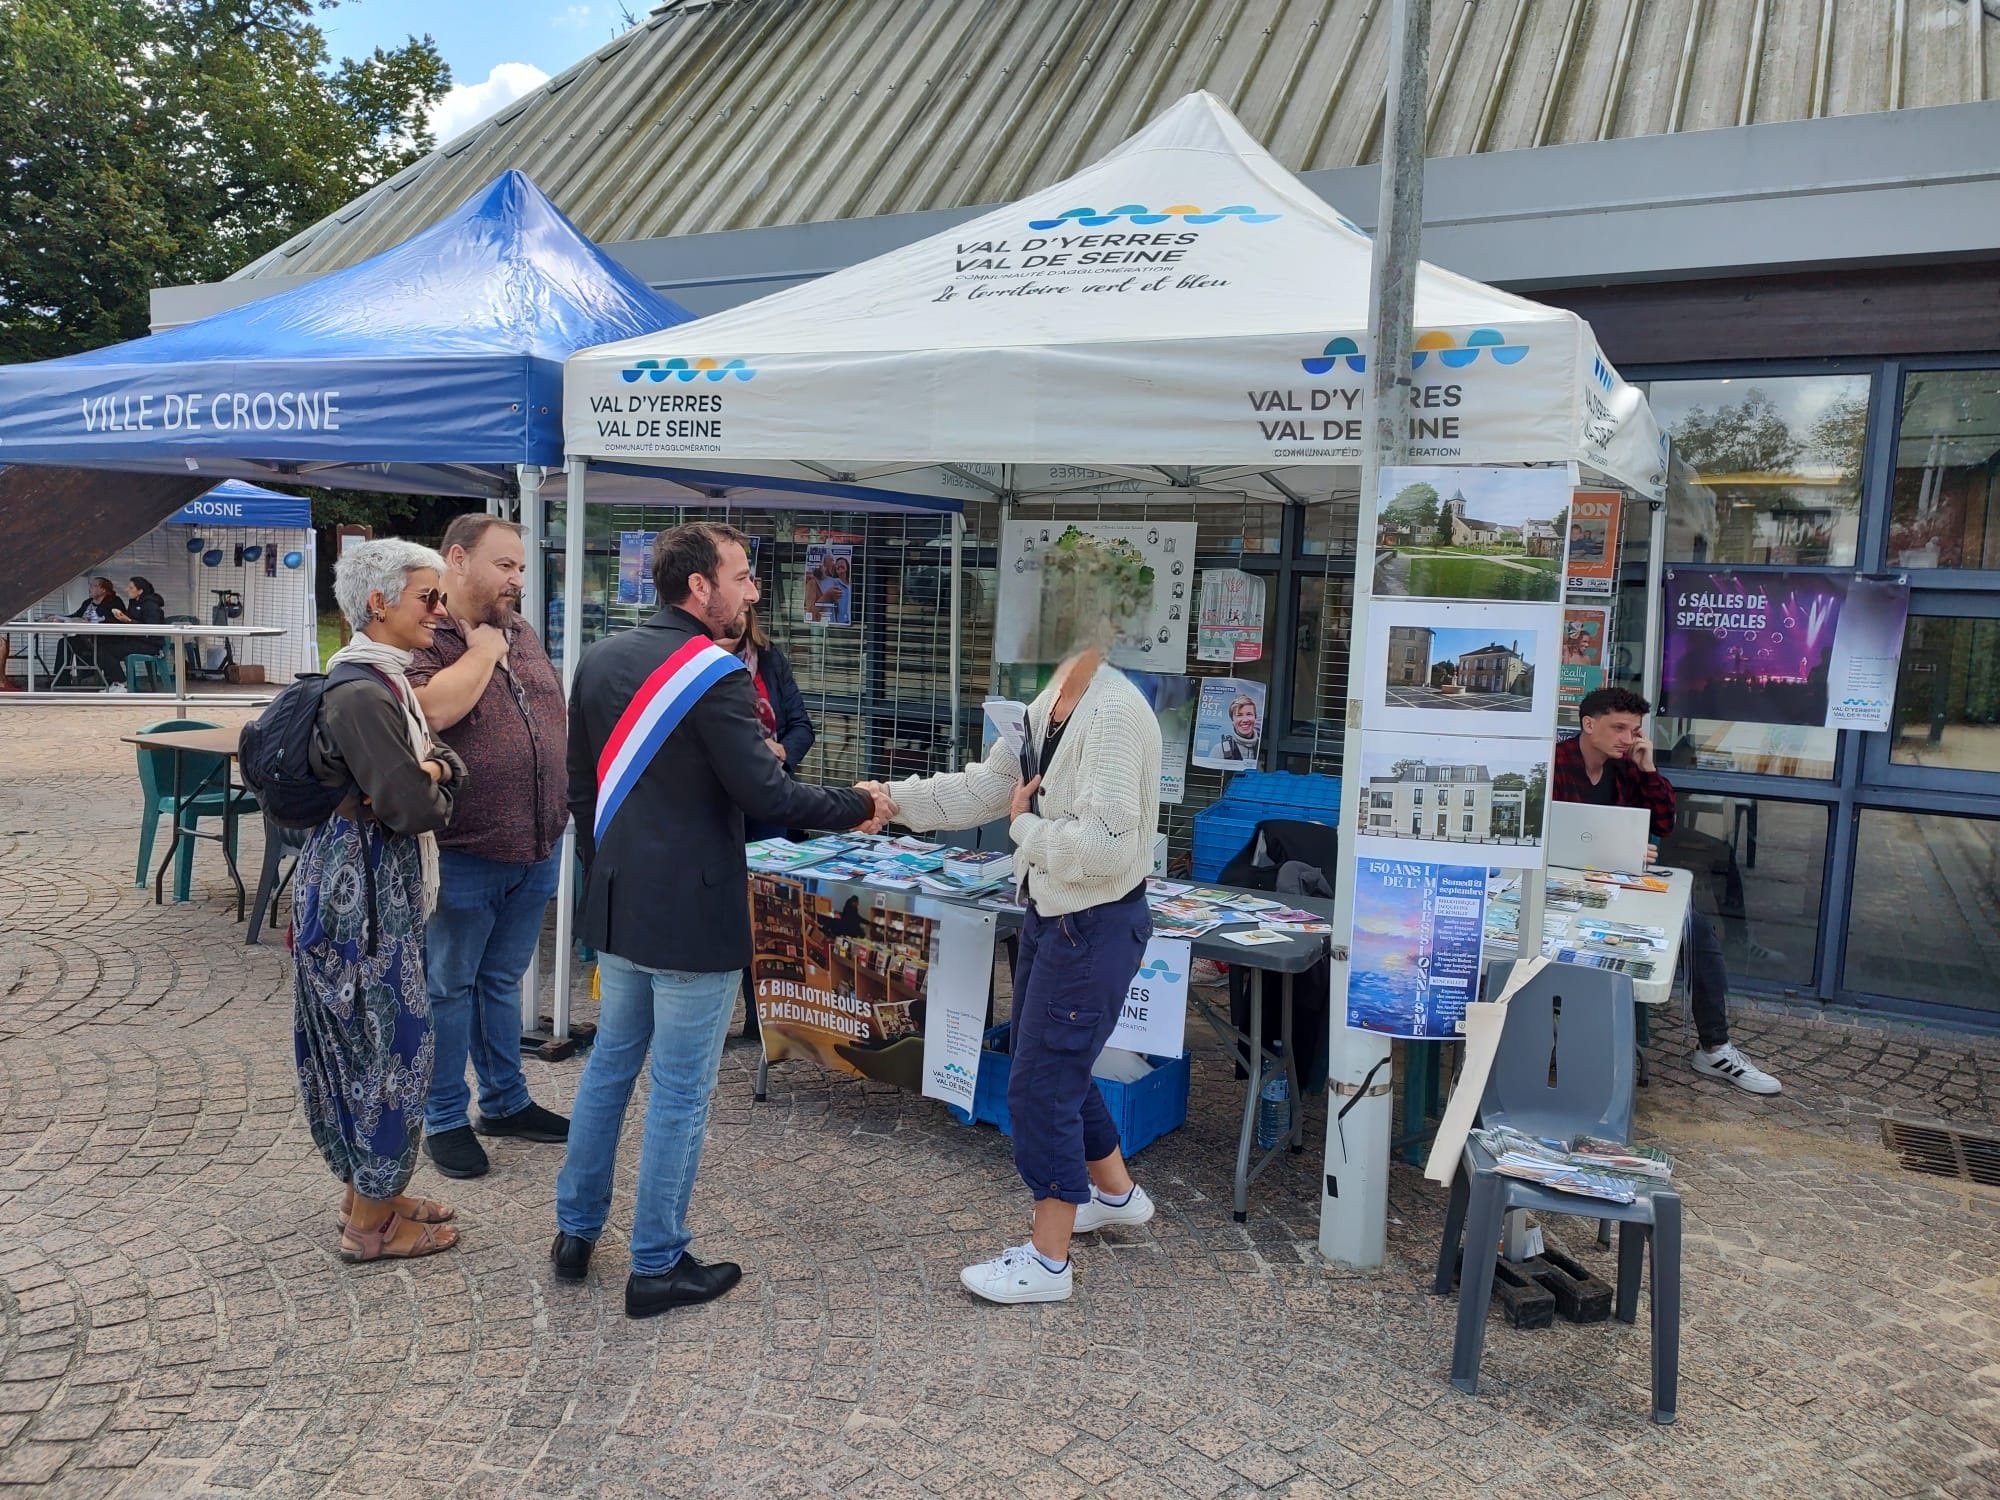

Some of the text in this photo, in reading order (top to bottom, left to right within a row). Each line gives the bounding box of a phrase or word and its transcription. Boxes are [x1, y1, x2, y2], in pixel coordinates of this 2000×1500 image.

[956, 232, 1200, 255] VAL D'YERRES
[955, 250, 1188, 273] VAL DE SEINE
[967, 281, 1073, 300] territoire
[1082, 276, 1137, 294] vert
[1140, 275, 1171, 292] et
[1175, 273, 1233, 290] bleu
[590, 394, 723, 413] VAL D'YERRES
[1248, 389, 1303, 412] VAL
[82, 391, 340, 432] VILLE DE CROSNE
[597, 420, 722, 438] VAL DE SEINE
[1258, 420, 1315, 441] VAL
[1323, 420, 1362, 441] DE
[604, 443, 653, 452] COMMUNAUTÉ
[184, 501, 243, 517] CROSNE
[1678, 592, 1767, 610] 6 SALLES DE
[1676, 611, 1767, 630] SPECTACLES
[1201, 702, 1220, 710] OCT
[1201, 709, 1223, 718] 2024
[1369, 862, 1422, 877] 150 ANS
[1383, 875, 1404, 888] DE
[1473, 880, 1482, 888] 21
[1439, 887, 1484, 896] septembre
[758, 979, 872, 1018] 6 BIBLIOTHÈQUES
[759, 1001, 768, 1020] 5
[771, 998, 870, 1039] MÉDIATHÈQUES
